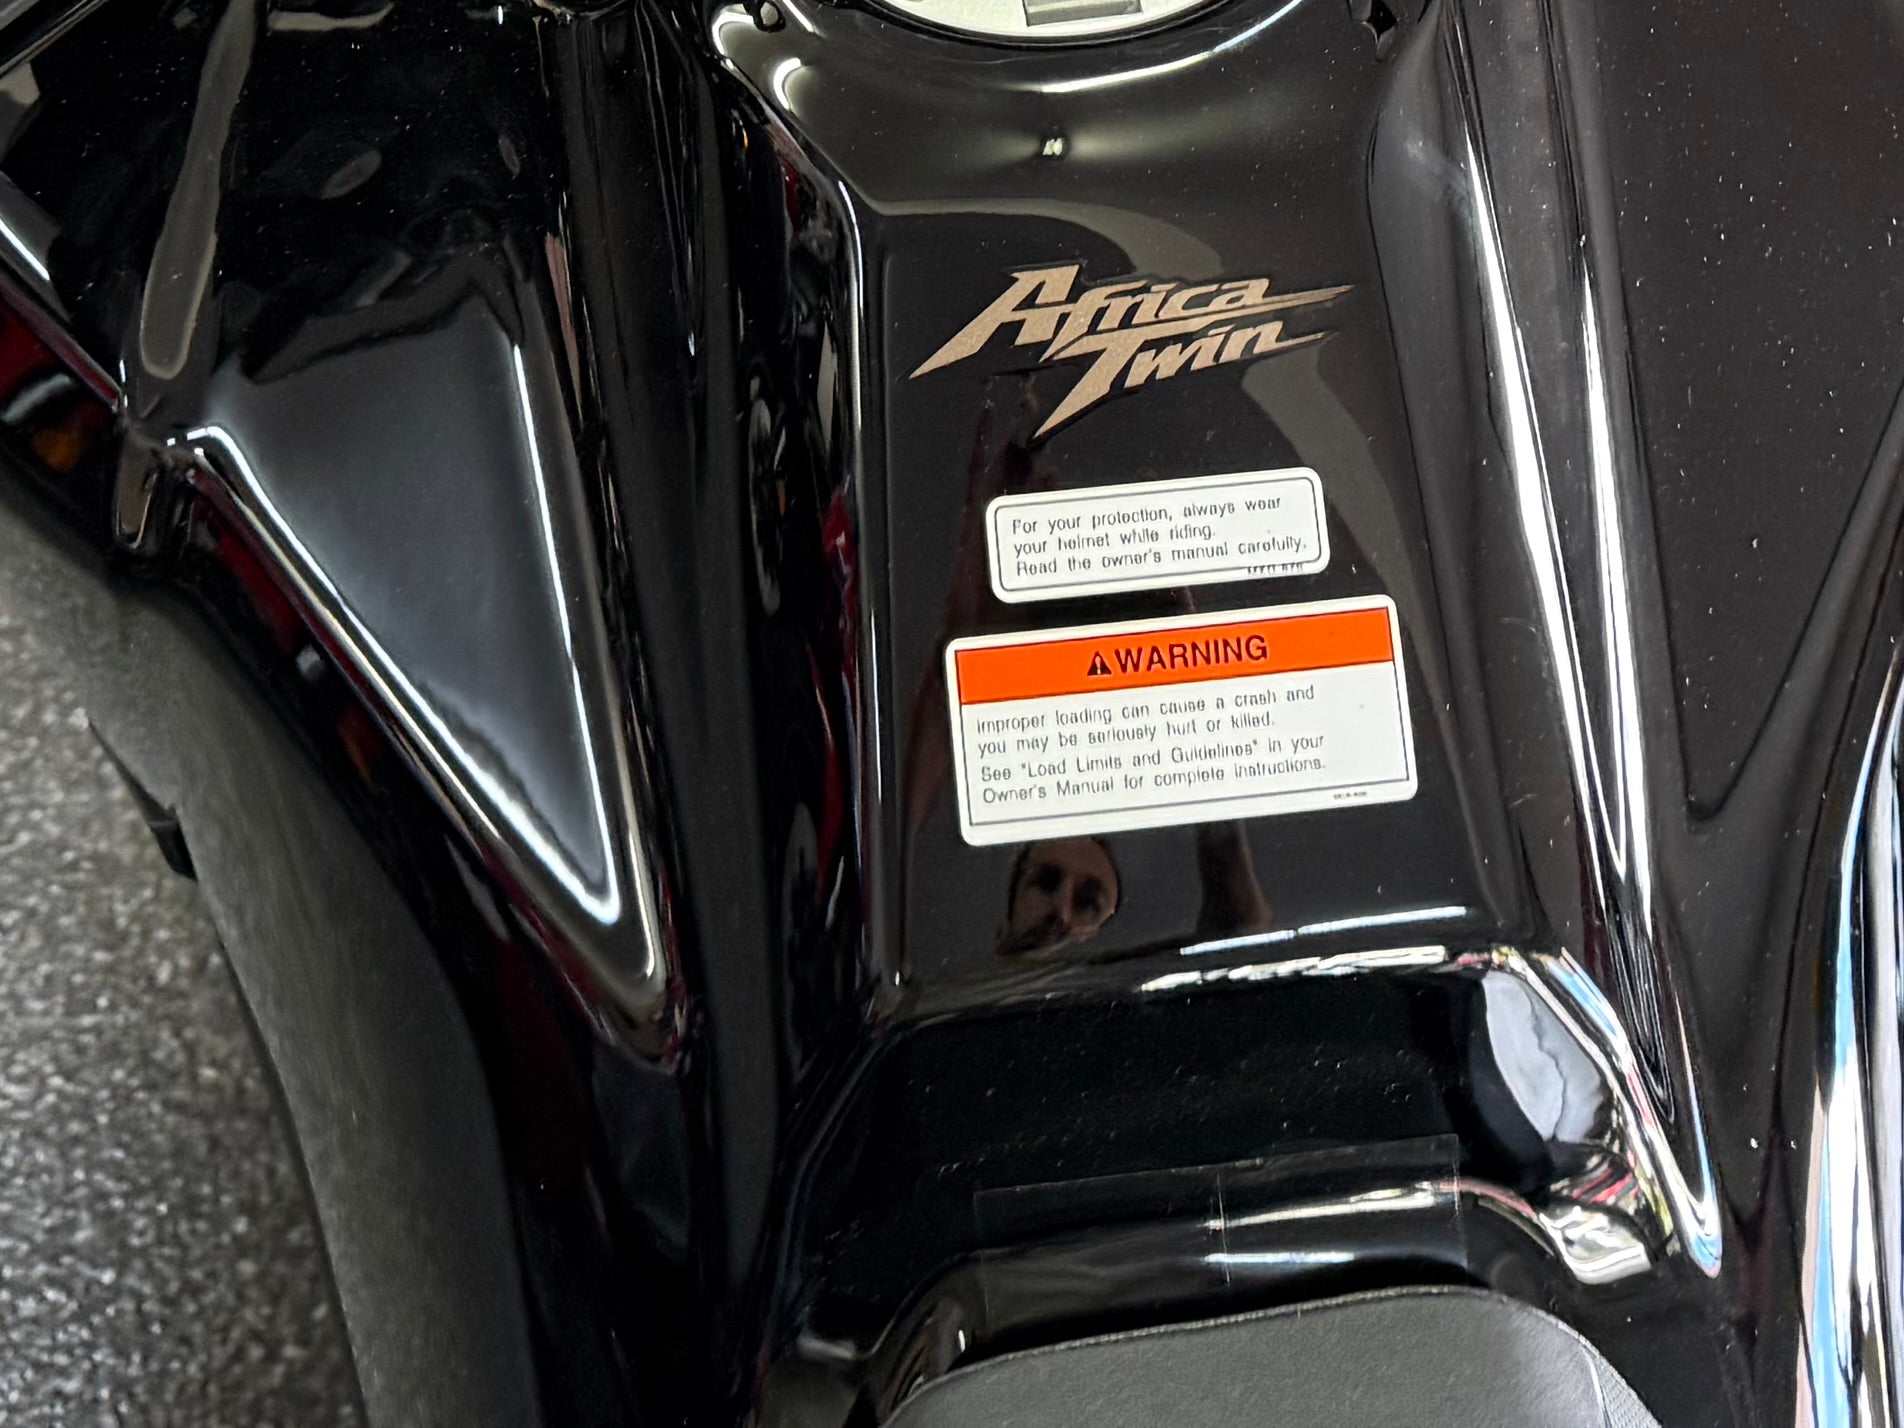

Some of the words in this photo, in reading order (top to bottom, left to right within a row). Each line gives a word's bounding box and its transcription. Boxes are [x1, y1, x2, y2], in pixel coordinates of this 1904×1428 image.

[909, 264, 1355, 380] Africa
[1033, 312, 1329, 438] Twin
[1013, 519, 1037, 534] For
[1048, 516, 1081, 535] your
[1092, 507, 1173, 530] protection,
[1183, 502, 1235, 517] always
[1245, 497, 1281, 512] wear
[1014, 541, 1047, 558] your
[1058, 532, 1110, 551] helmet
[1120, 527, 1159, 545] while
[1017, 557, 1057, 576] Read
[1068, 556, 1091, 572] the
[1102, 547, 1161, 568] owner's
[1172, 541, 1228, 561] manual
[1114, 634, 1268, 673] WARNING
[977, 714, 1046, 734] Improper
[1056, 708, 1111, 726] loading
[1122, 704, 1149, 719] can
[1160, 699, 1205, 715] cause
[1216, 697, 1224, 710] a
[1235, 689, 1276, 707] crash
[1286, 684, 1314, 702] and
[978, 740, 1006, 758] you
[1017, 736, 1048, 752] may
[1058, 732, 1077, 747] be
[1088, 725, 1156, 744] seriously
[1167, 719, 1196, 736] hurt
[1206, 719, 1221, 733] or
[981, 766, 1011, 782] See
[1076, 754, 1122, 773] Limits
[1132, 749, 1161, 767] and
[1268, 737, 1282, 753] in
[1291, 735, 1324, 754] your
[983, 784, 1047, 804] Owner's
[1056, 775, 1114, 797] Manual
[1124, 774, 1144, 790] for
[1154, 766, 1225, 787] complete
